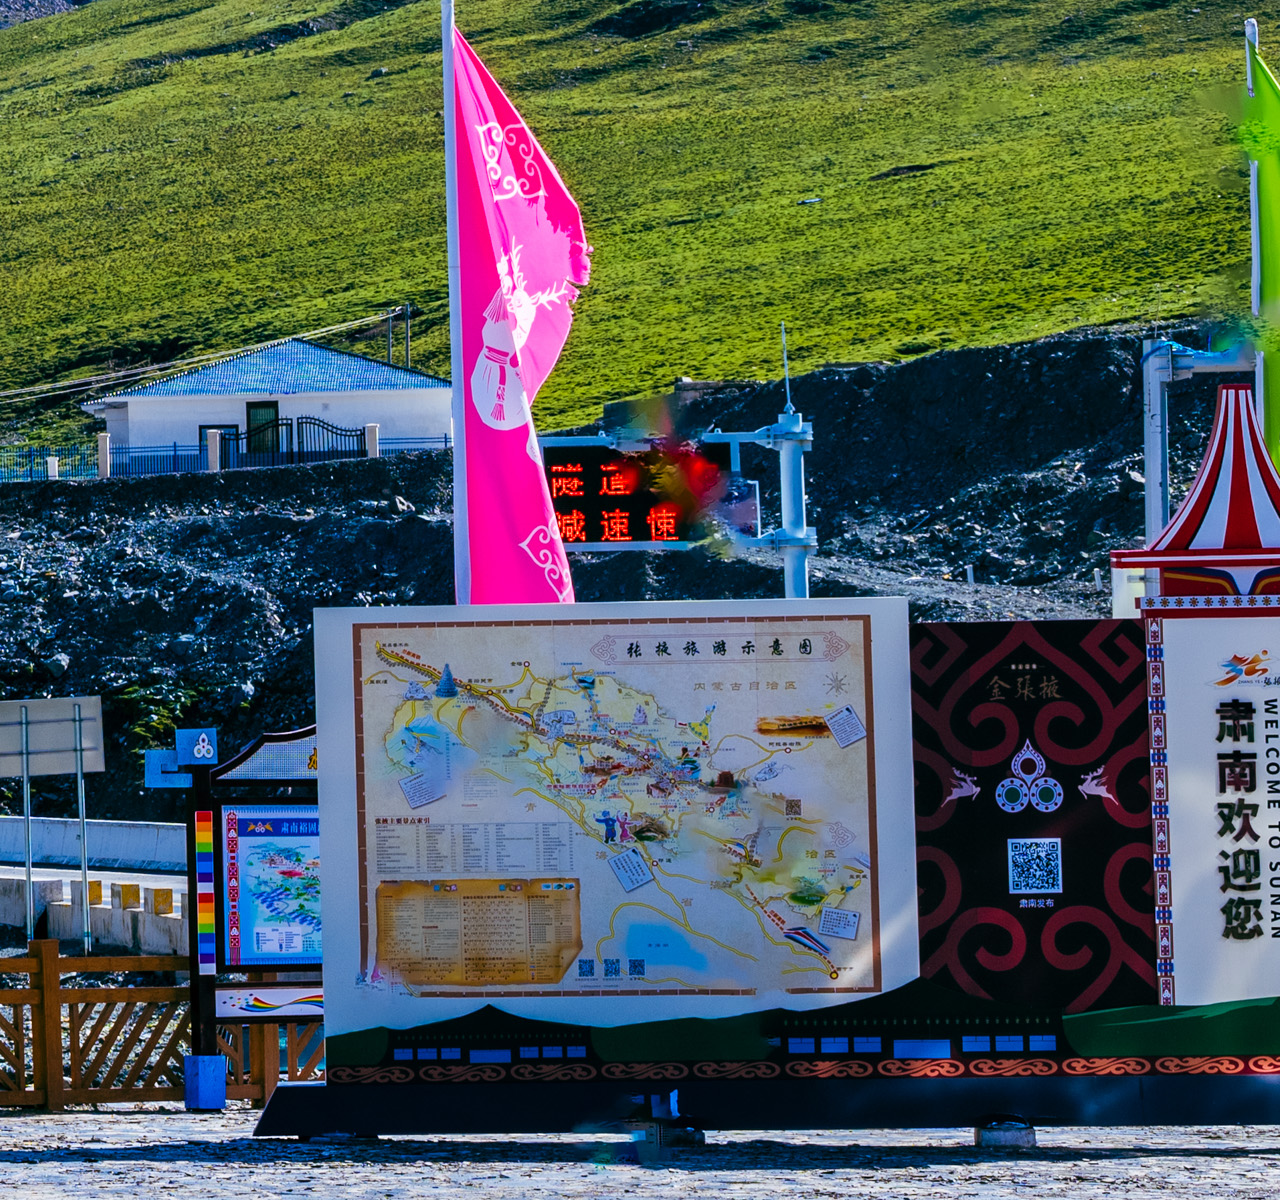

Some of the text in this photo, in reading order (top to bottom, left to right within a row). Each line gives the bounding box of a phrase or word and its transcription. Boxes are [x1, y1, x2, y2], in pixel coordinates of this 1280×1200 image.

[626, 637, 813, 659] 张掖旅游示意图
[693, 680, 798, 692] 内蒙古自治区
[1264, 698, 1280, 810] WELCOME
[281, 821, 319, 834] 肃南裕固
[1215, 698, 1264, 941] 肃南欢迎您
